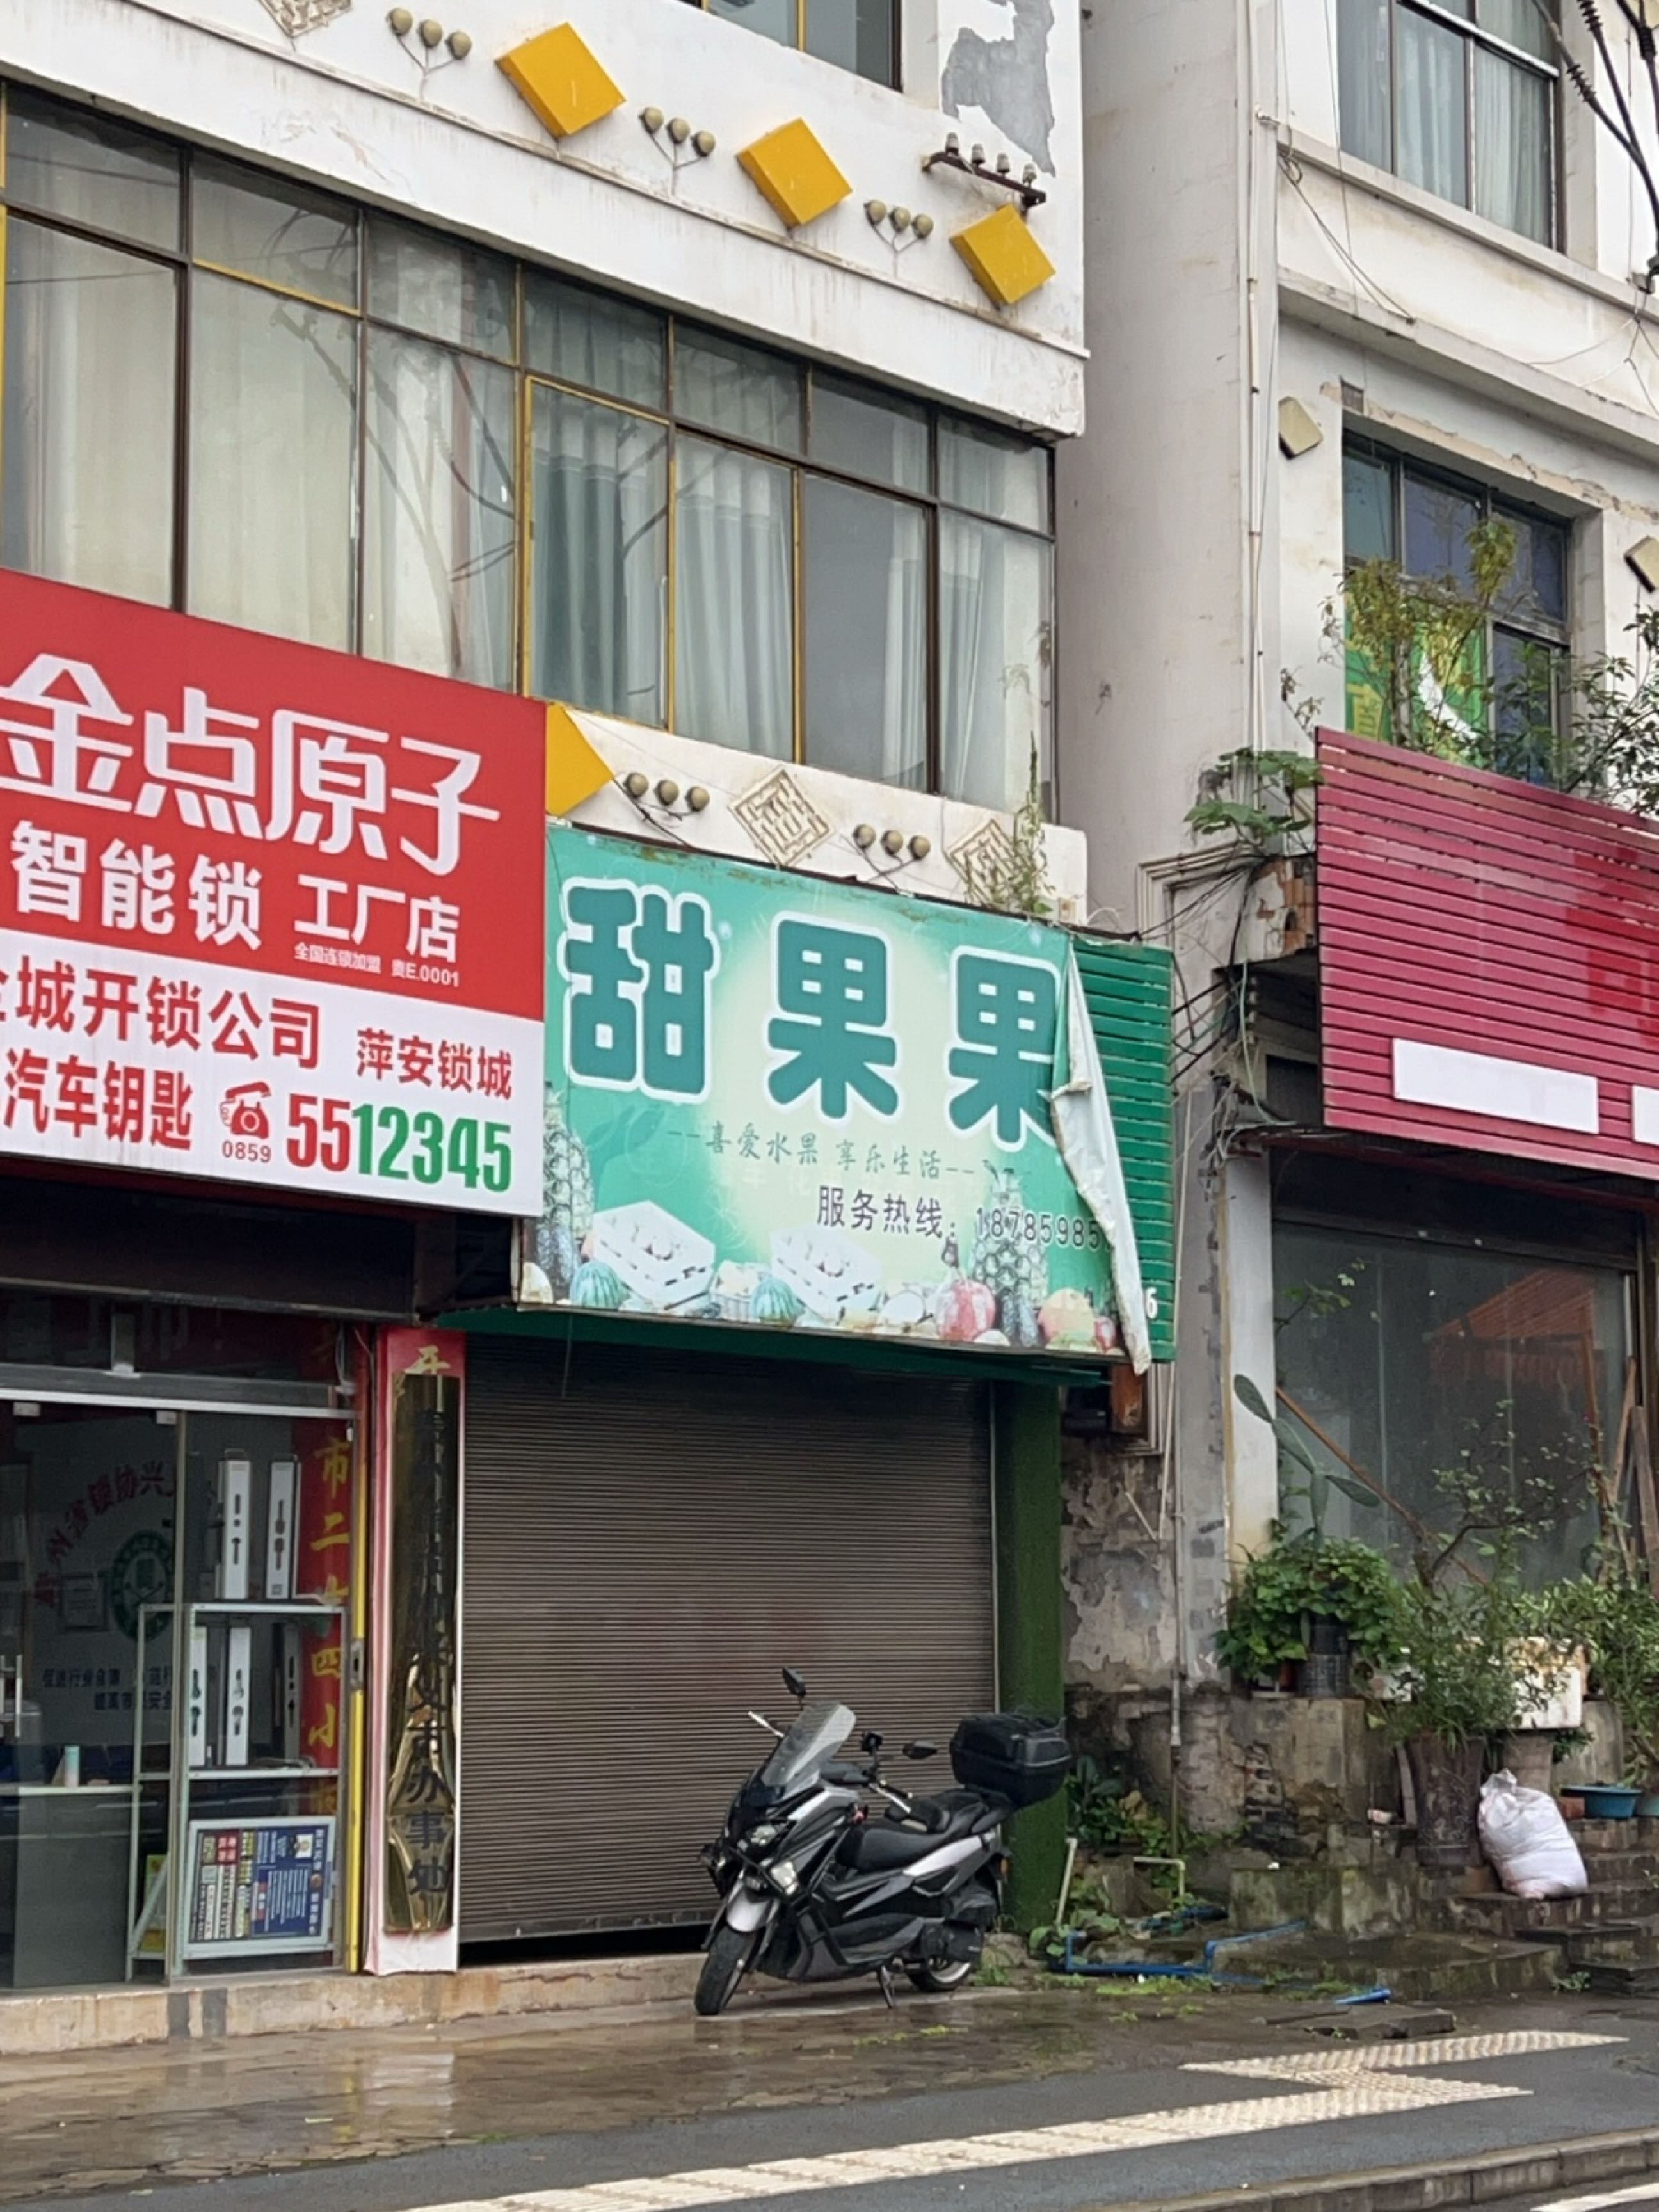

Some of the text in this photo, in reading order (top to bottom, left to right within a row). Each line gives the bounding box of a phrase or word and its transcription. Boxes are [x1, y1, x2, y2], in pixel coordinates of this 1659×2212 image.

[0, 653, 501, 876] 金点原子
[10, 820, 262, 950] 智能锁
[294, 874, 460, 963] 工厂店
[0, 954, 319, 1069] 城开锁公司
[357, 1027, 513, 1100] 萍安锁城
[561, 879, 1059, 1149] 甜果果
[4, 1047, 194, 1151] 汽车钥匙
[221, 1093, 512, 1193] 0859 5512345
[976, 1207, 1112, 1251] 18785985
